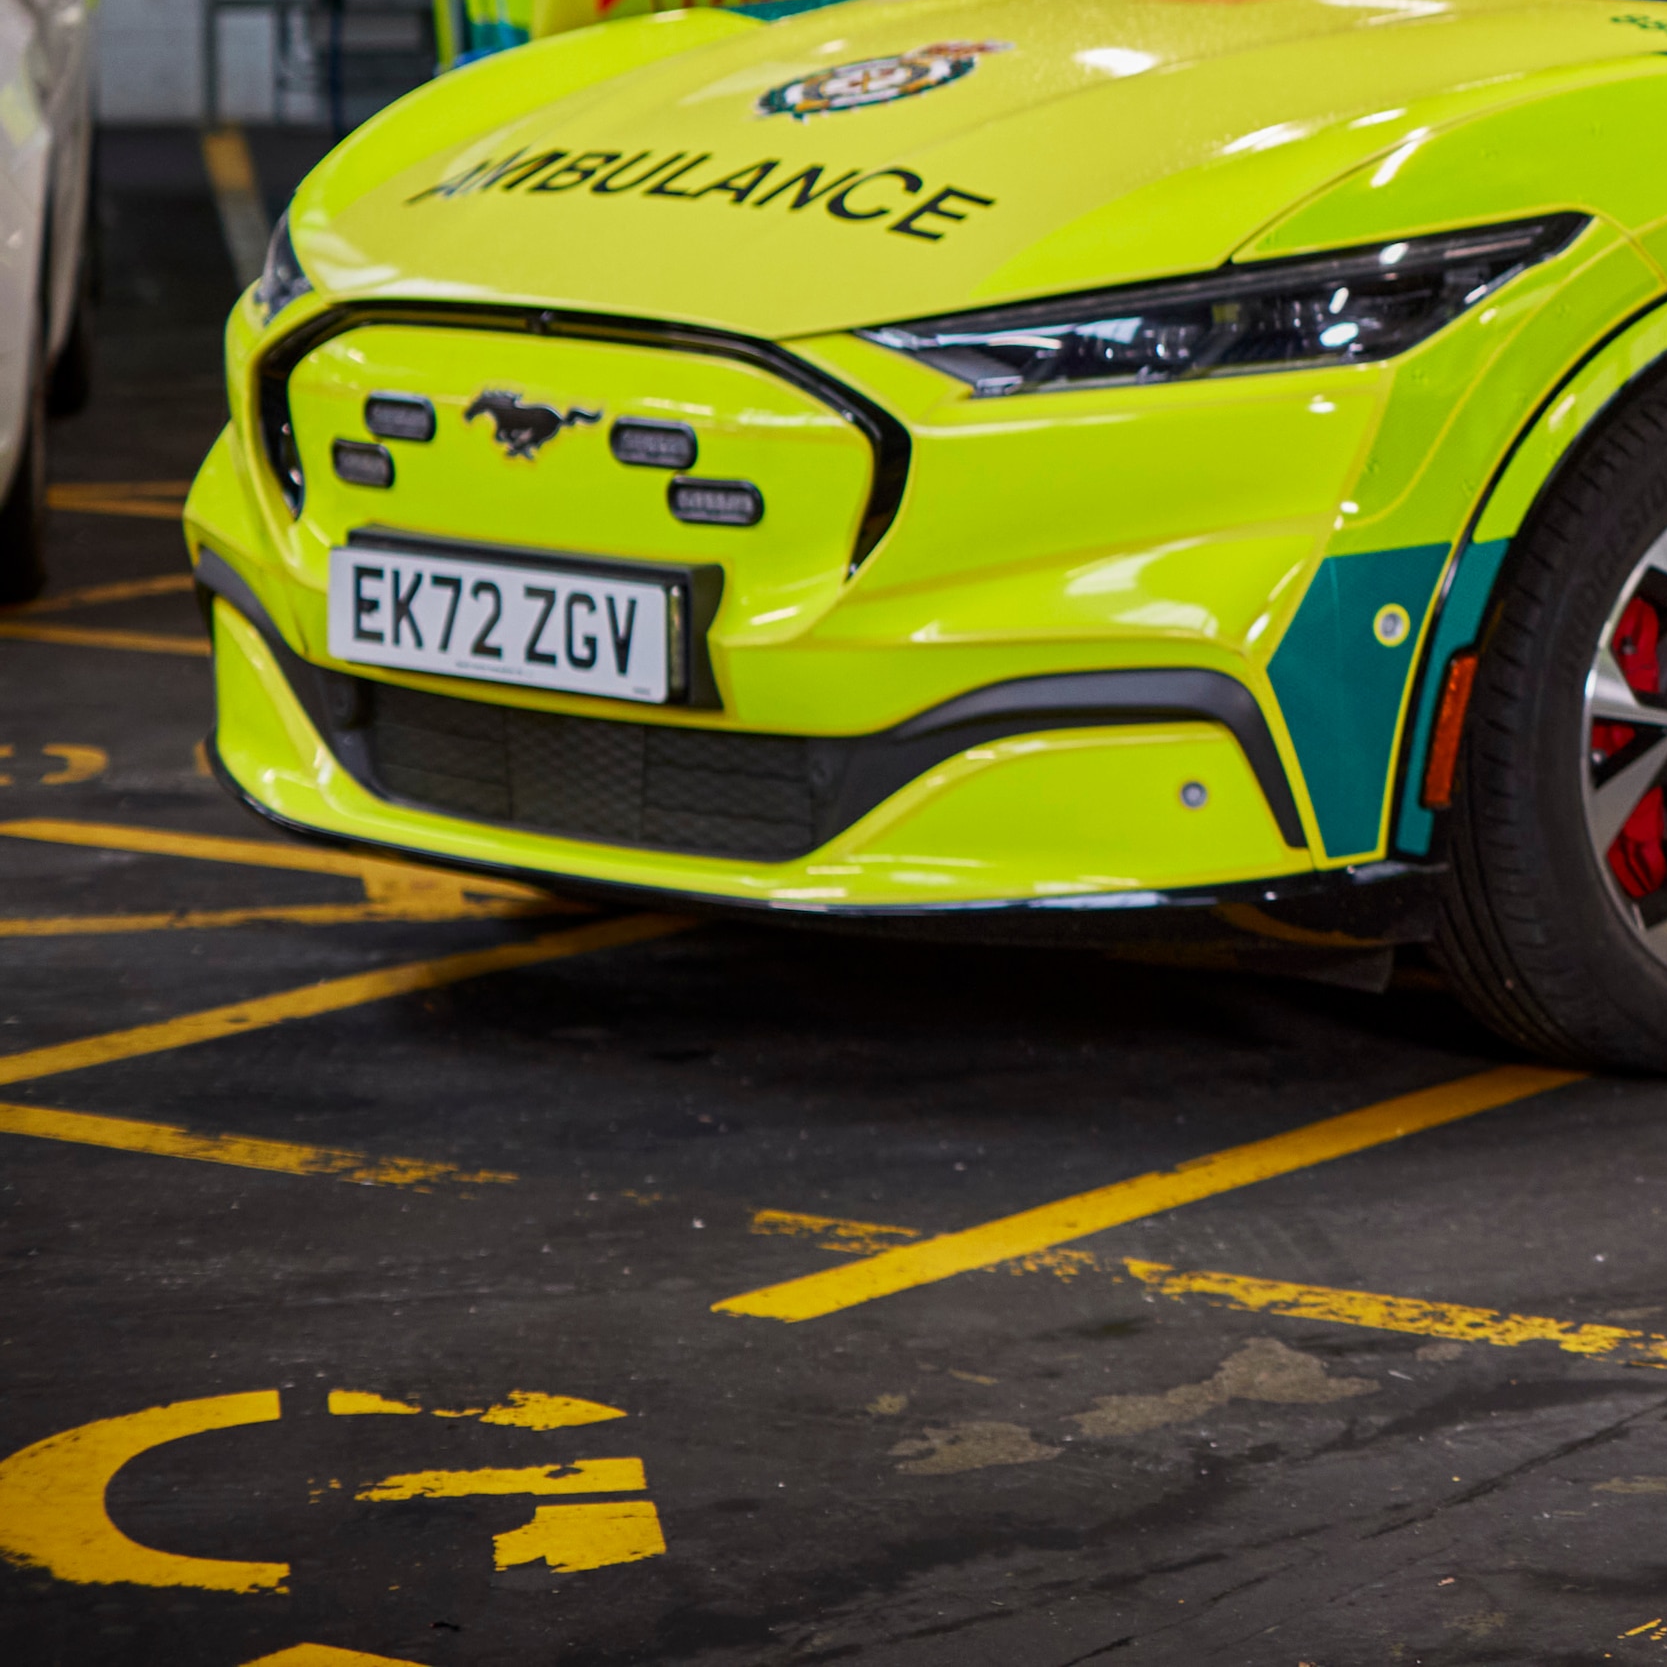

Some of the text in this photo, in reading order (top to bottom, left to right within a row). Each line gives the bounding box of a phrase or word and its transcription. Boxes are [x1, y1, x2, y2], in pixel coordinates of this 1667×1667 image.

[405, 145, 996, 243] AMBULANCE
[353, 564, 637, 678] EK72 ZGV
